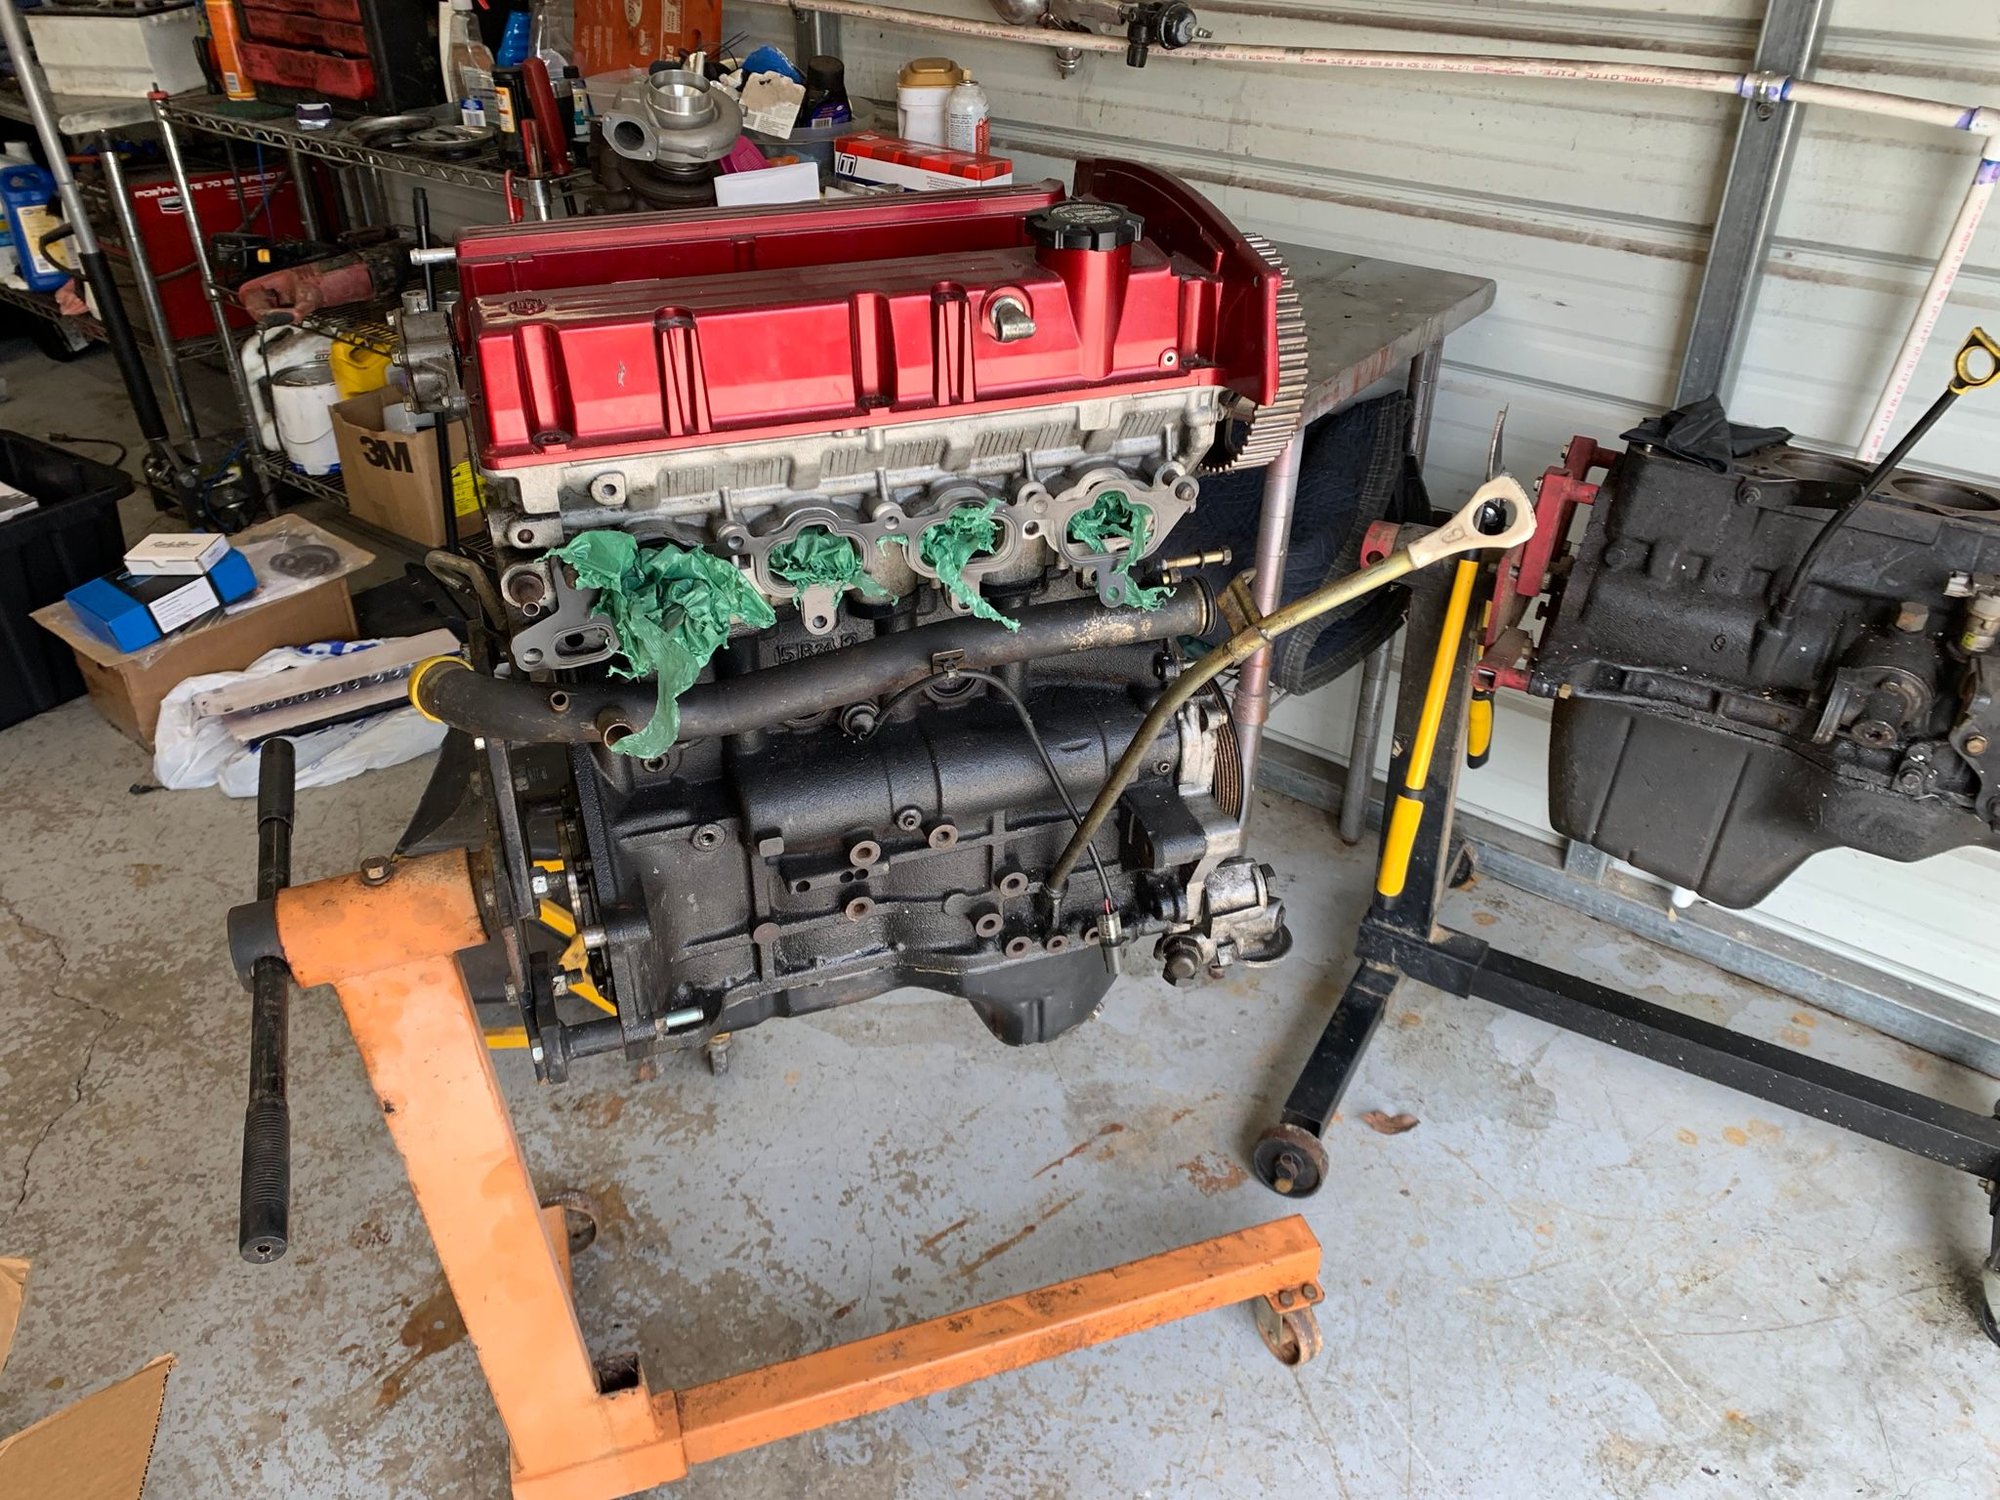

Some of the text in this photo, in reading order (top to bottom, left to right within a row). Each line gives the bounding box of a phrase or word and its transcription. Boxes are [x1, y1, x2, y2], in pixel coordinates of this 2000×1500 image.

[1543, 68, 1576, 77] PIPE
[1586, 72, 1663, 83] CHARLOTTE
[359, 436, 414, 473] 3M
